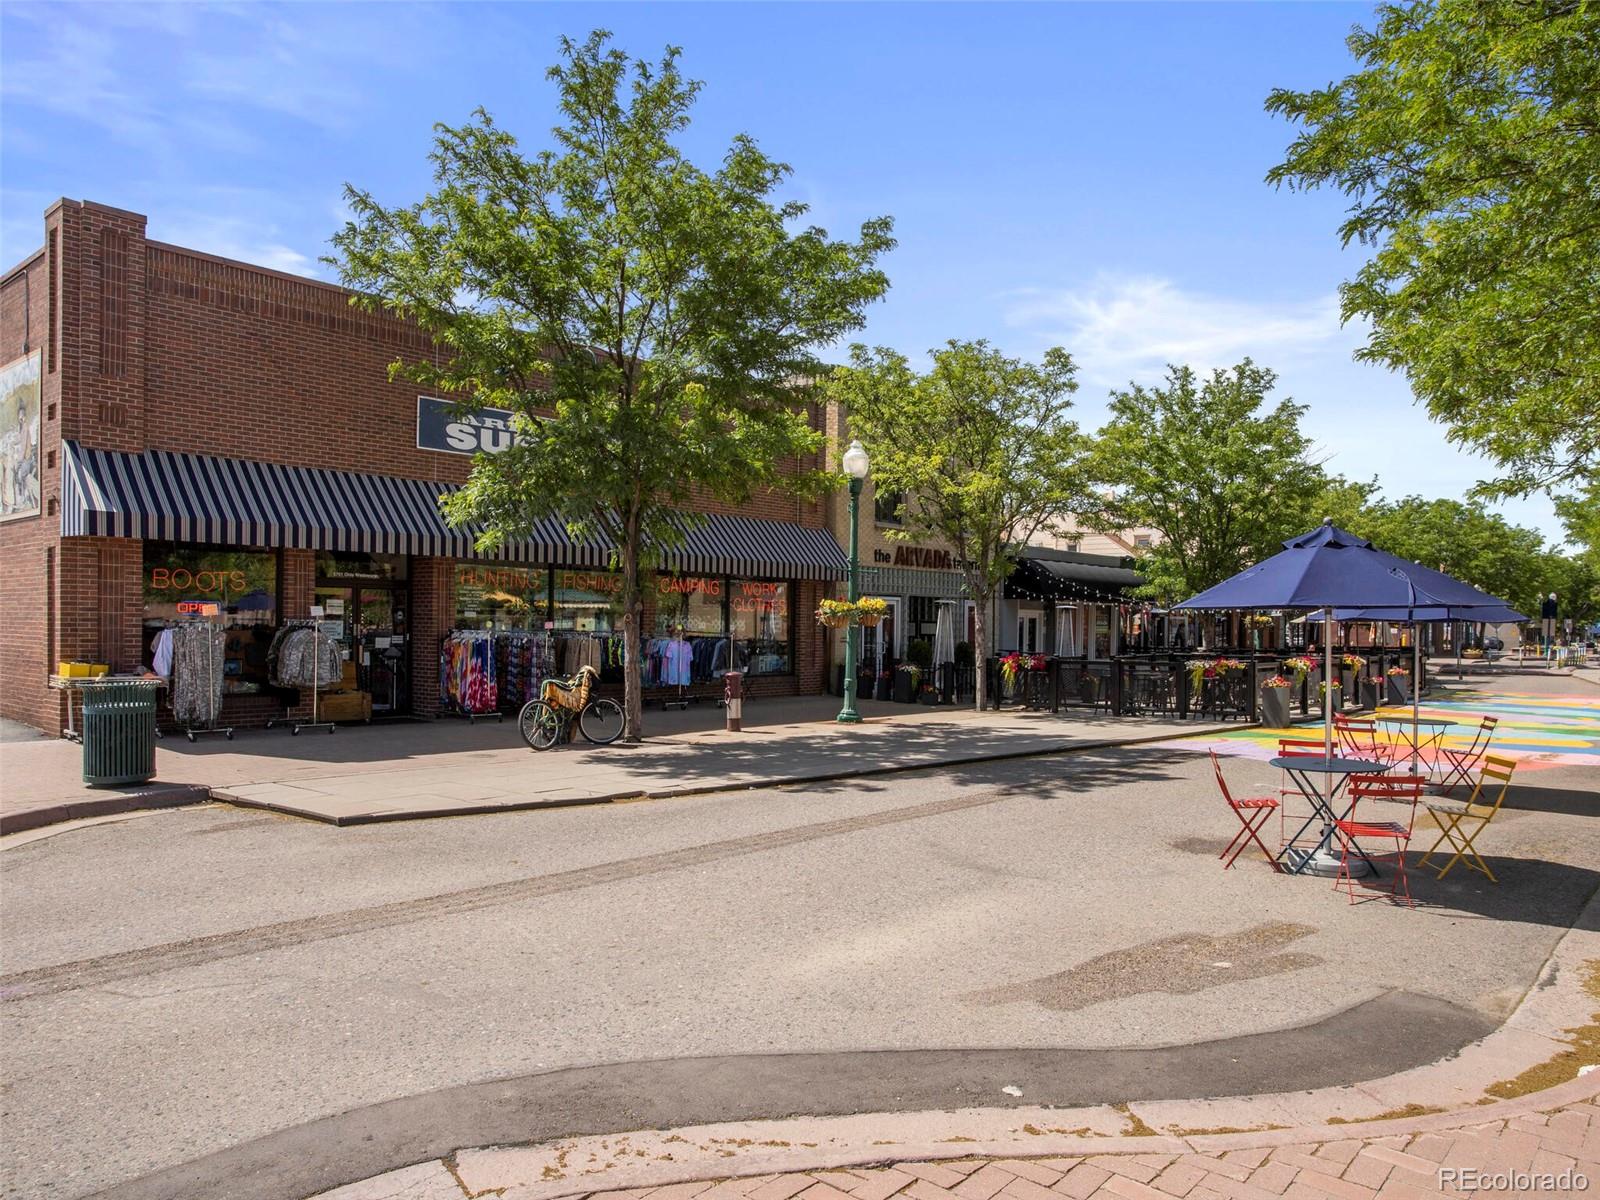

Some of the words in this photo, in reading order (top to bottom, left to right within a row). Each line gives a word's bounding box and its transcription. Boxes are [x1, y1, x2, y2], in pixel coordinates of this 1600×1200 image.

[874, 549, 891, 563] the
[894, 545, 953, 570] ARVADA
[952, 557, 981, 571] taern
[152, 568, 246, 592] BOOTS
[460, 568, 541, 591] HUNTING
[563, 573, 624, 592] FISHING
[660, 577, 720, 596] CAMPING
[742, 581, 777, 596] WORK
